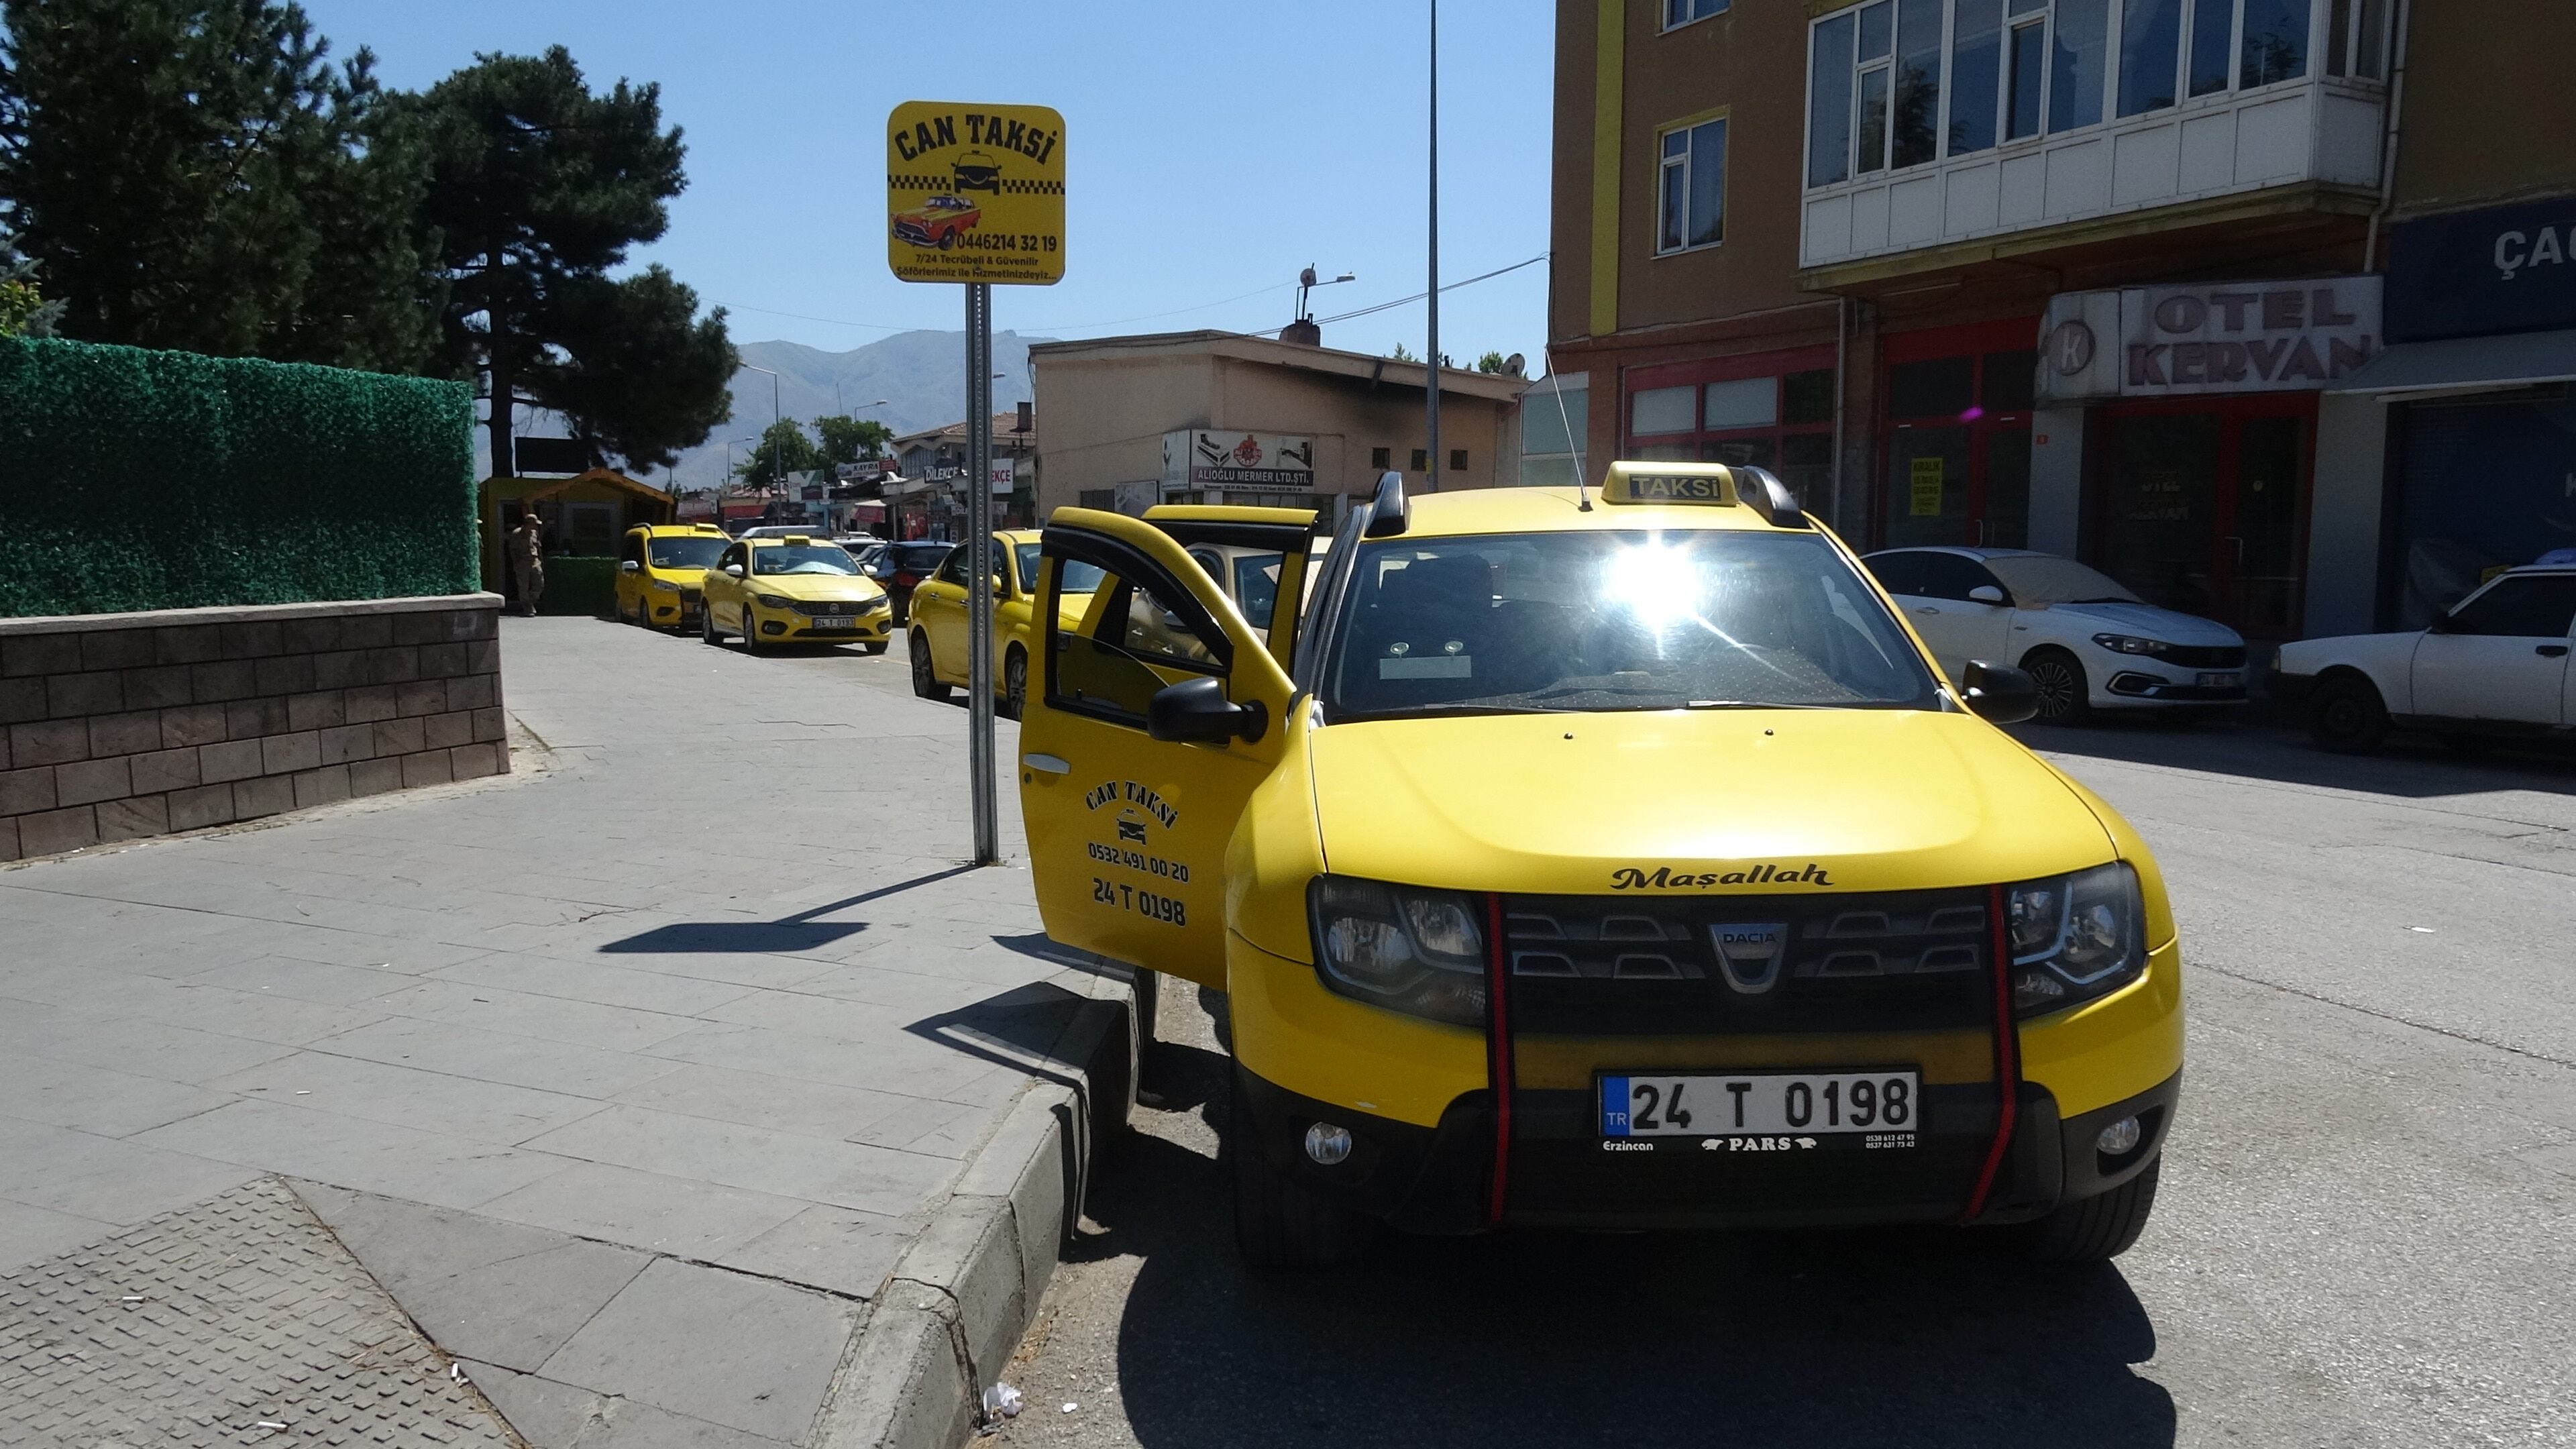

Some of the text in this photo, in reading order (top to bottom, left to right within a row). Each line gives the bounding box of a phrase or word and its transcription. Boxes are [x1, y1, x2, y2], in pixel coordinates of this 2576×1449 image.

[895, 115, 1057, 165] CAN TAKSİ
[1020, 235, 1038, 251] 32
[1042, 235, 1057, 252] 19
[916, 254, 1038, 266] 7/24 Tecrübeli & Güvenilir
[2154, 288, 2355, 333] OTEL
[2128, 335, 2372, 387] KERVAN
[1237, 471, 1273, 482] MERMER
[1085, 780, 1179, 829] CAN TAKSİ
[1088, 843, 1189, 883] 0532 491 00 20
[1610, 863, 1835, 889] Maşallah
[1093, 877, 1186, 926] 24 T 0198
[1723, 932, 1777, 944] DACIA
[1632, 1078, 1909, 1130] 24 T 0198
[1608, 1112, 1626, 1126] TR
[1603, 1140, 1654, 1151] Erzincan
[1729, 1137, 1792, 1151] PARS
